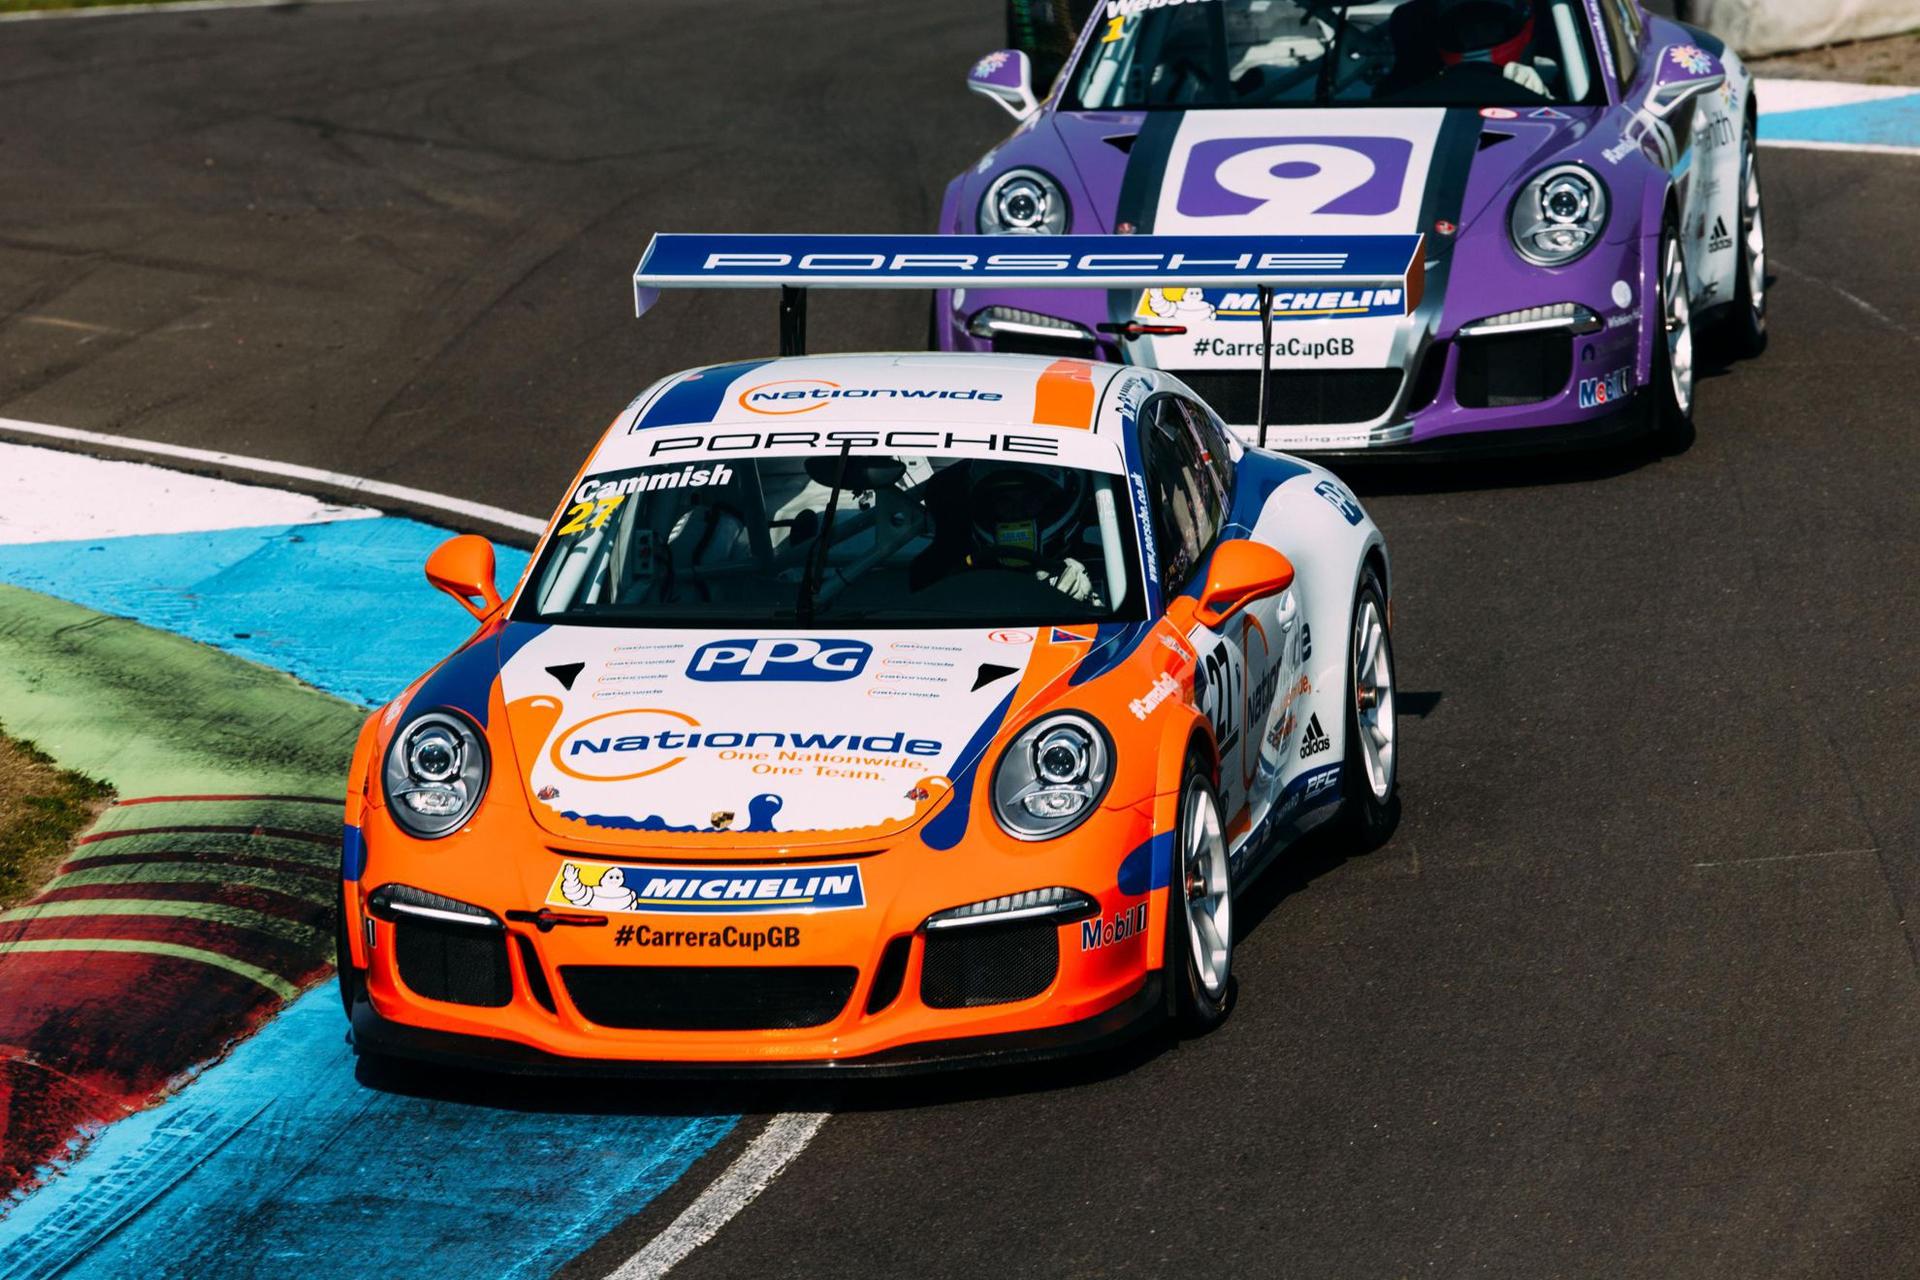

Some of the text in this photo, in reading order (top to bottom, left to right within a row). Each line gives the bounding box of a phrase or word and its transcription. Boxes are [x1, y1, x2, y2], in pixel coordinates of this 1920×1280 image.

[1101, 15, 1125, 43] 1
[702, 253, 1349, 271] PORSCHE
[751, 388, 1004, 402] Nationwide
[648, 431, 1059, 457] PORSCHE
[574, 464, 734, 504] Cammish
[557, 495, 626, 537] 27
[695, 638, 865, 676] PPG
[1205, 640, 1233, 746] 27
[569, 730, 943, 757] Nationwide
[1299, 736, 1331, 760] adidas
[718, 750, 929, 772] One Nationwide,
[752, 763, 886, 781] One Team.
[1306, 767, 1341, 794] PFC
[641, 874, 854, 900] MICHELIN
[614, 925, 801, 951] #CarreraCupGB
[1081, 906, 1135, 952] Mobil
